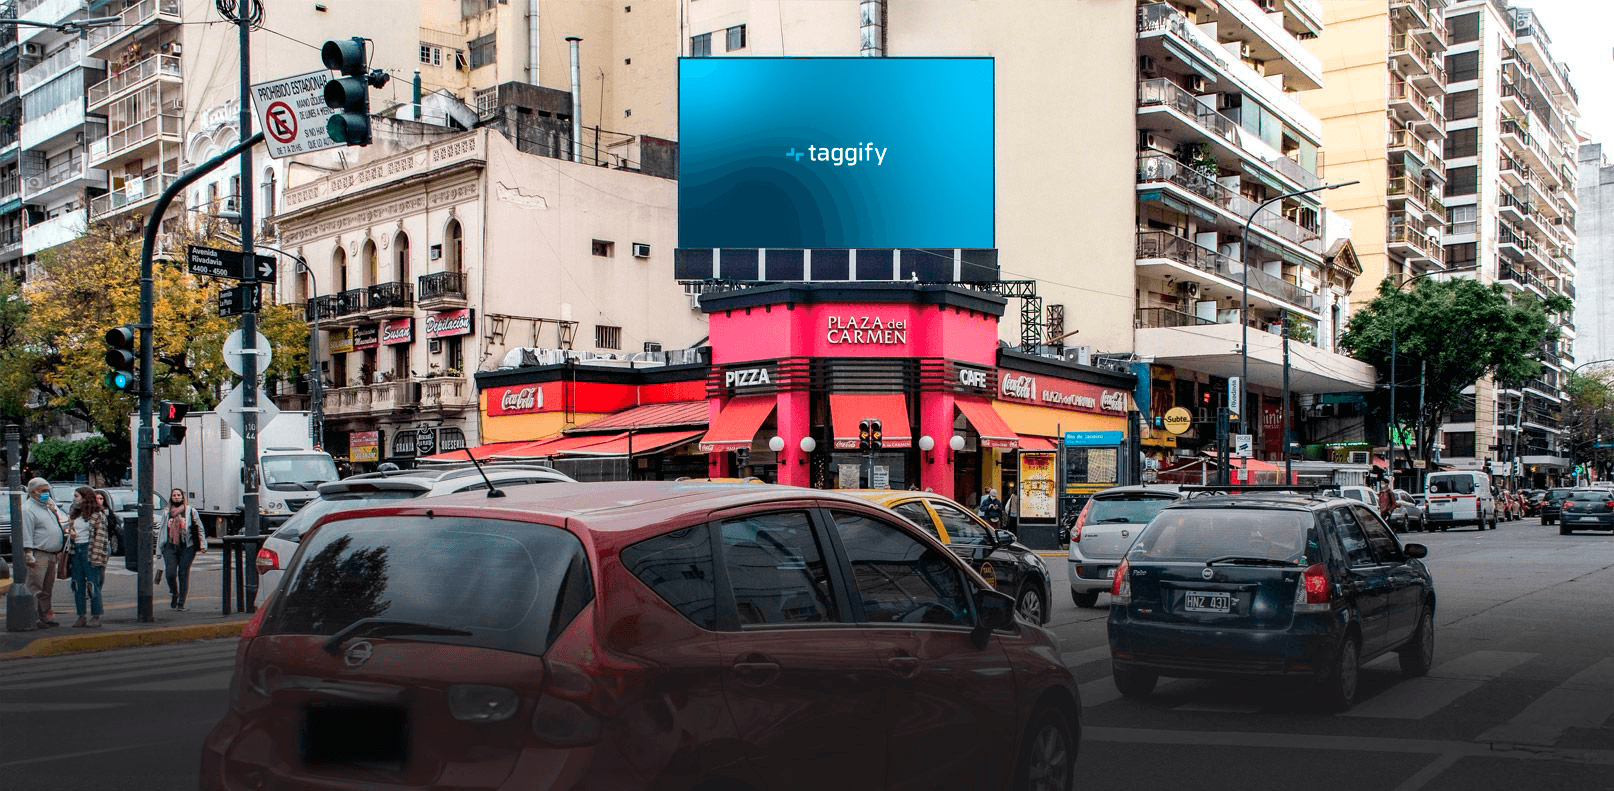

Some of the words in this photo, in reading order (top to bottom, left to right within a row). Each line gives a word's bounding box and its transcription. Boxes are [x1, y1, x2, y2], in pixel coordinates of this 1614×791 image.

[257, 82, 291, 101] PROHIBIDO
[291, 74, 327, 95] ESTACIONAR
[296, 98, 310, 108] MANO
[299, 110, 306, 120] DE
[306, 108, 316, 119] LUNES
[304, 129, 309, 138] SI
[309, 127, 316, 137] NO
[316, 126, 325, 136] HAY
[277, 146, 283, 155] DE
[308, 139, 317, 149] QUE
[808, 142, 887, 166] taggify
[192, 246, 217, 257] Avenida
[192, 255, 223, 266] Rivadavia
[192, 264, 208, 273] 4400
[213, 267, 228, 276] 4500
[426, 315, 469, 335] Depilación
[828, 316, 884, 329] PLAZA
[887, 319, 906, 329] del
[383, 325, 411, 341] Susan
[827, 330, 906, 344] CARMEN
[725, 368, 771, 388] PIZZA
[959, 369, 987, 388] CAFE
[1043, 389, 1061, 403] PLAZA
[1167, 415, 1188, 423] Subte
[1187, 596, 1205, 608] HNZ
[1210, 597, 1228, 609] 431
